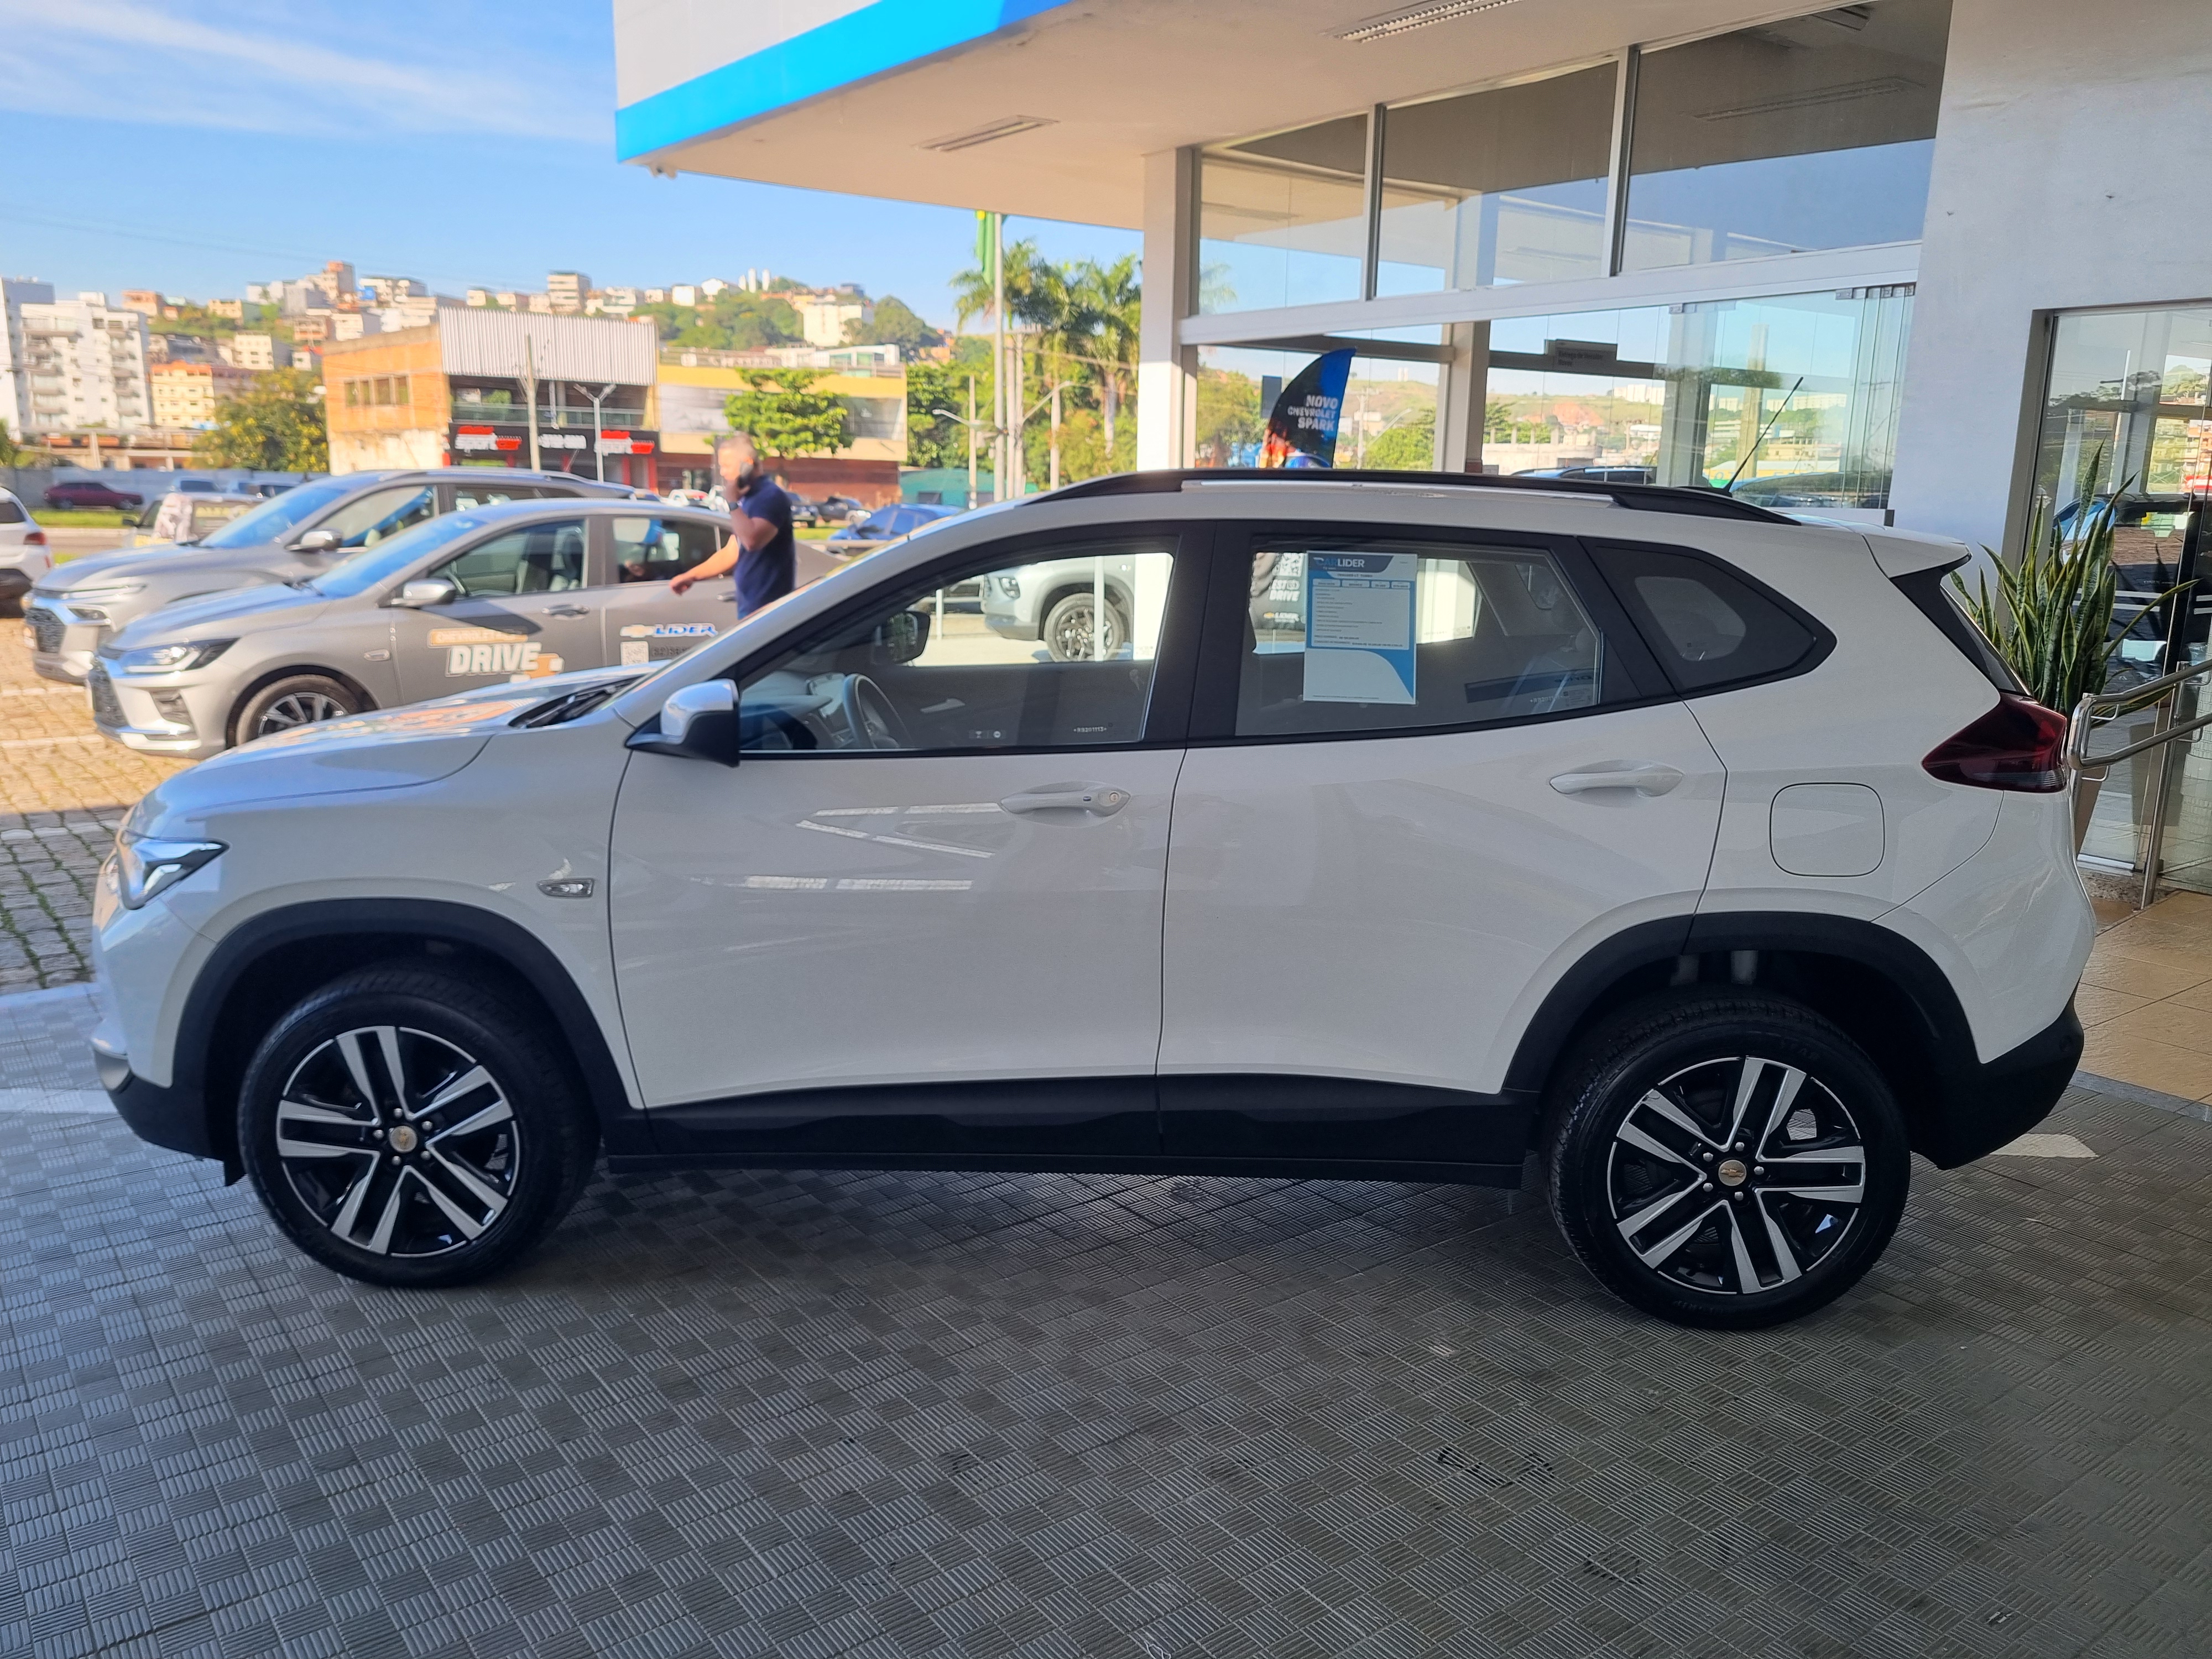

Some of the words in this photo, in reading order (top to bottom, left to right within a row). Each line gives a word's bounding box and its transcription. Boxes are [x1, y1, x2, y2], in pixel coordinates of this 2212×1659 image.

[1306, 394, 1338, 409] NOVO
[1287, 405, 1335, 419] CHEVROLET
[1297, 416, 1334, 431] SPARK
[1270, 579, 1287, 590] EST
[1269, 590, 1300, 602] DRIVE
[654, 624, 718, 637] LIDER
[449, 641, 542, 675] DRIVE
